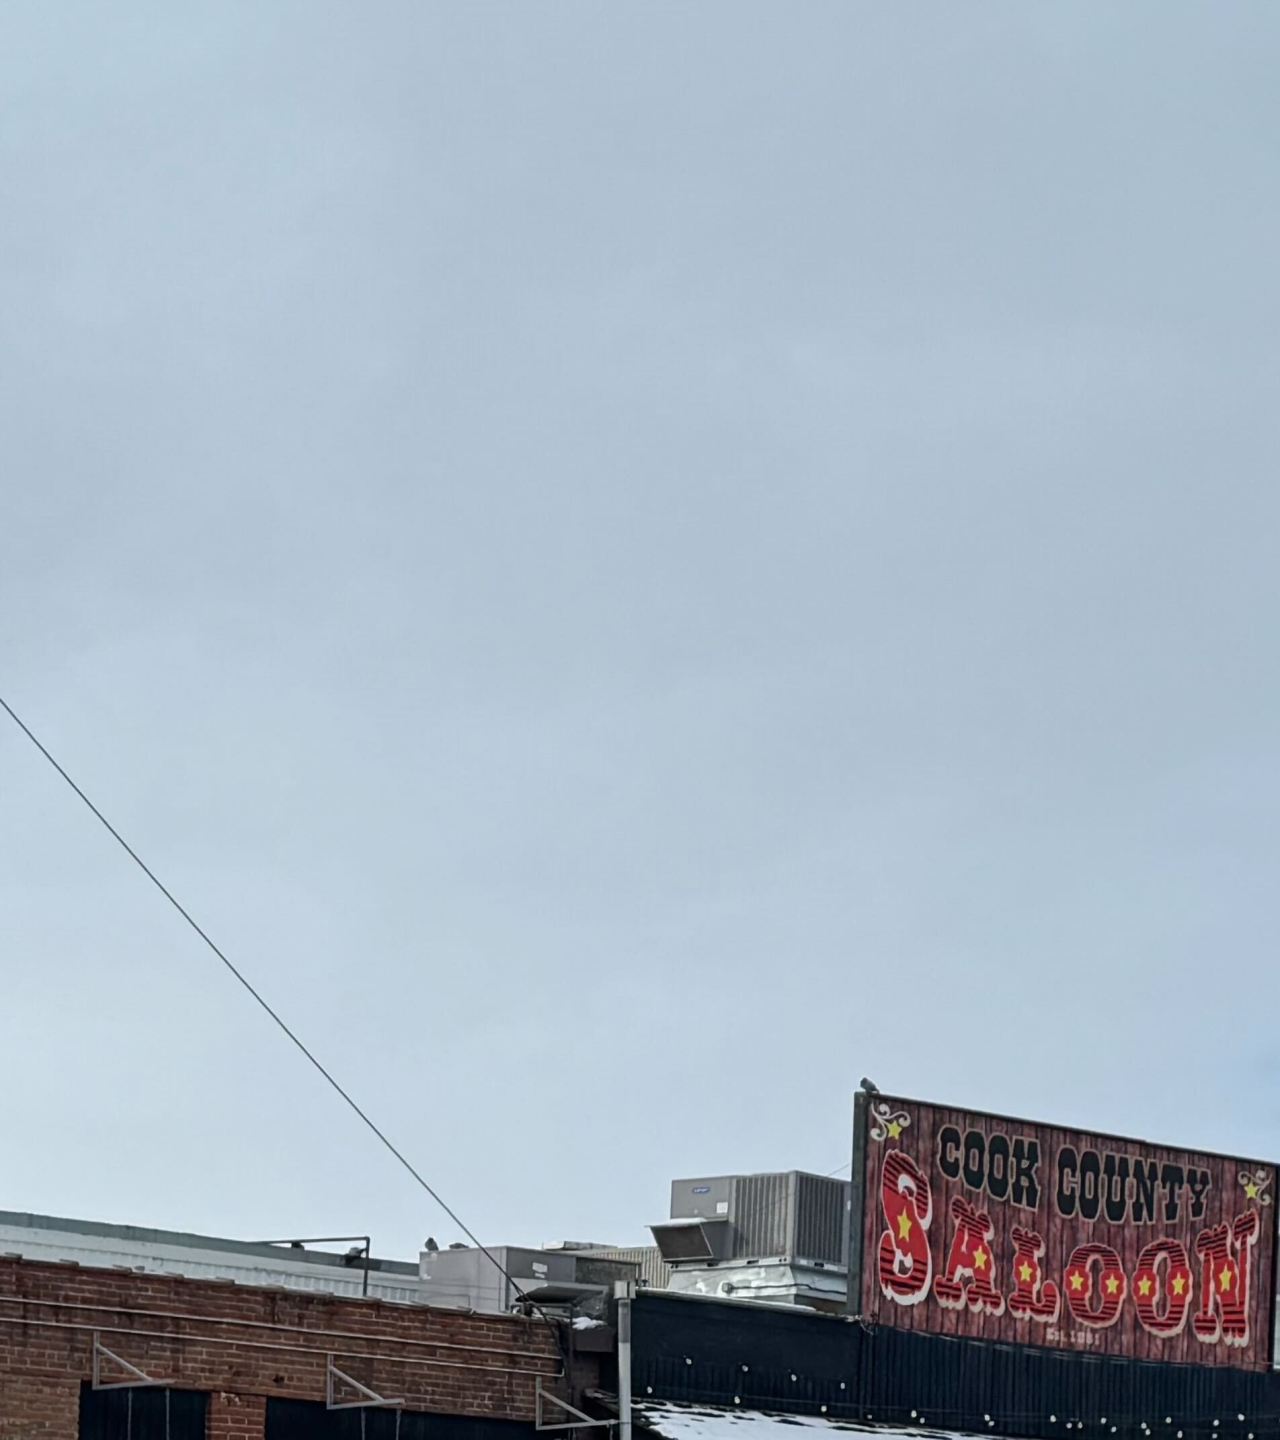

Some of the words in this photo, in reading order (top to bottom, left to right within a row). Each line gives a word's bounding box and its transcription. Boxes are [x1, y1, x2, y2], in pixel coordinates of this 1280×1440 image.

[879, 1148, 1260, 1347] SALOON
[937, 1125, 1041, 1212] COOK
[1055, 1145, 1211, 1225] COUNTY
